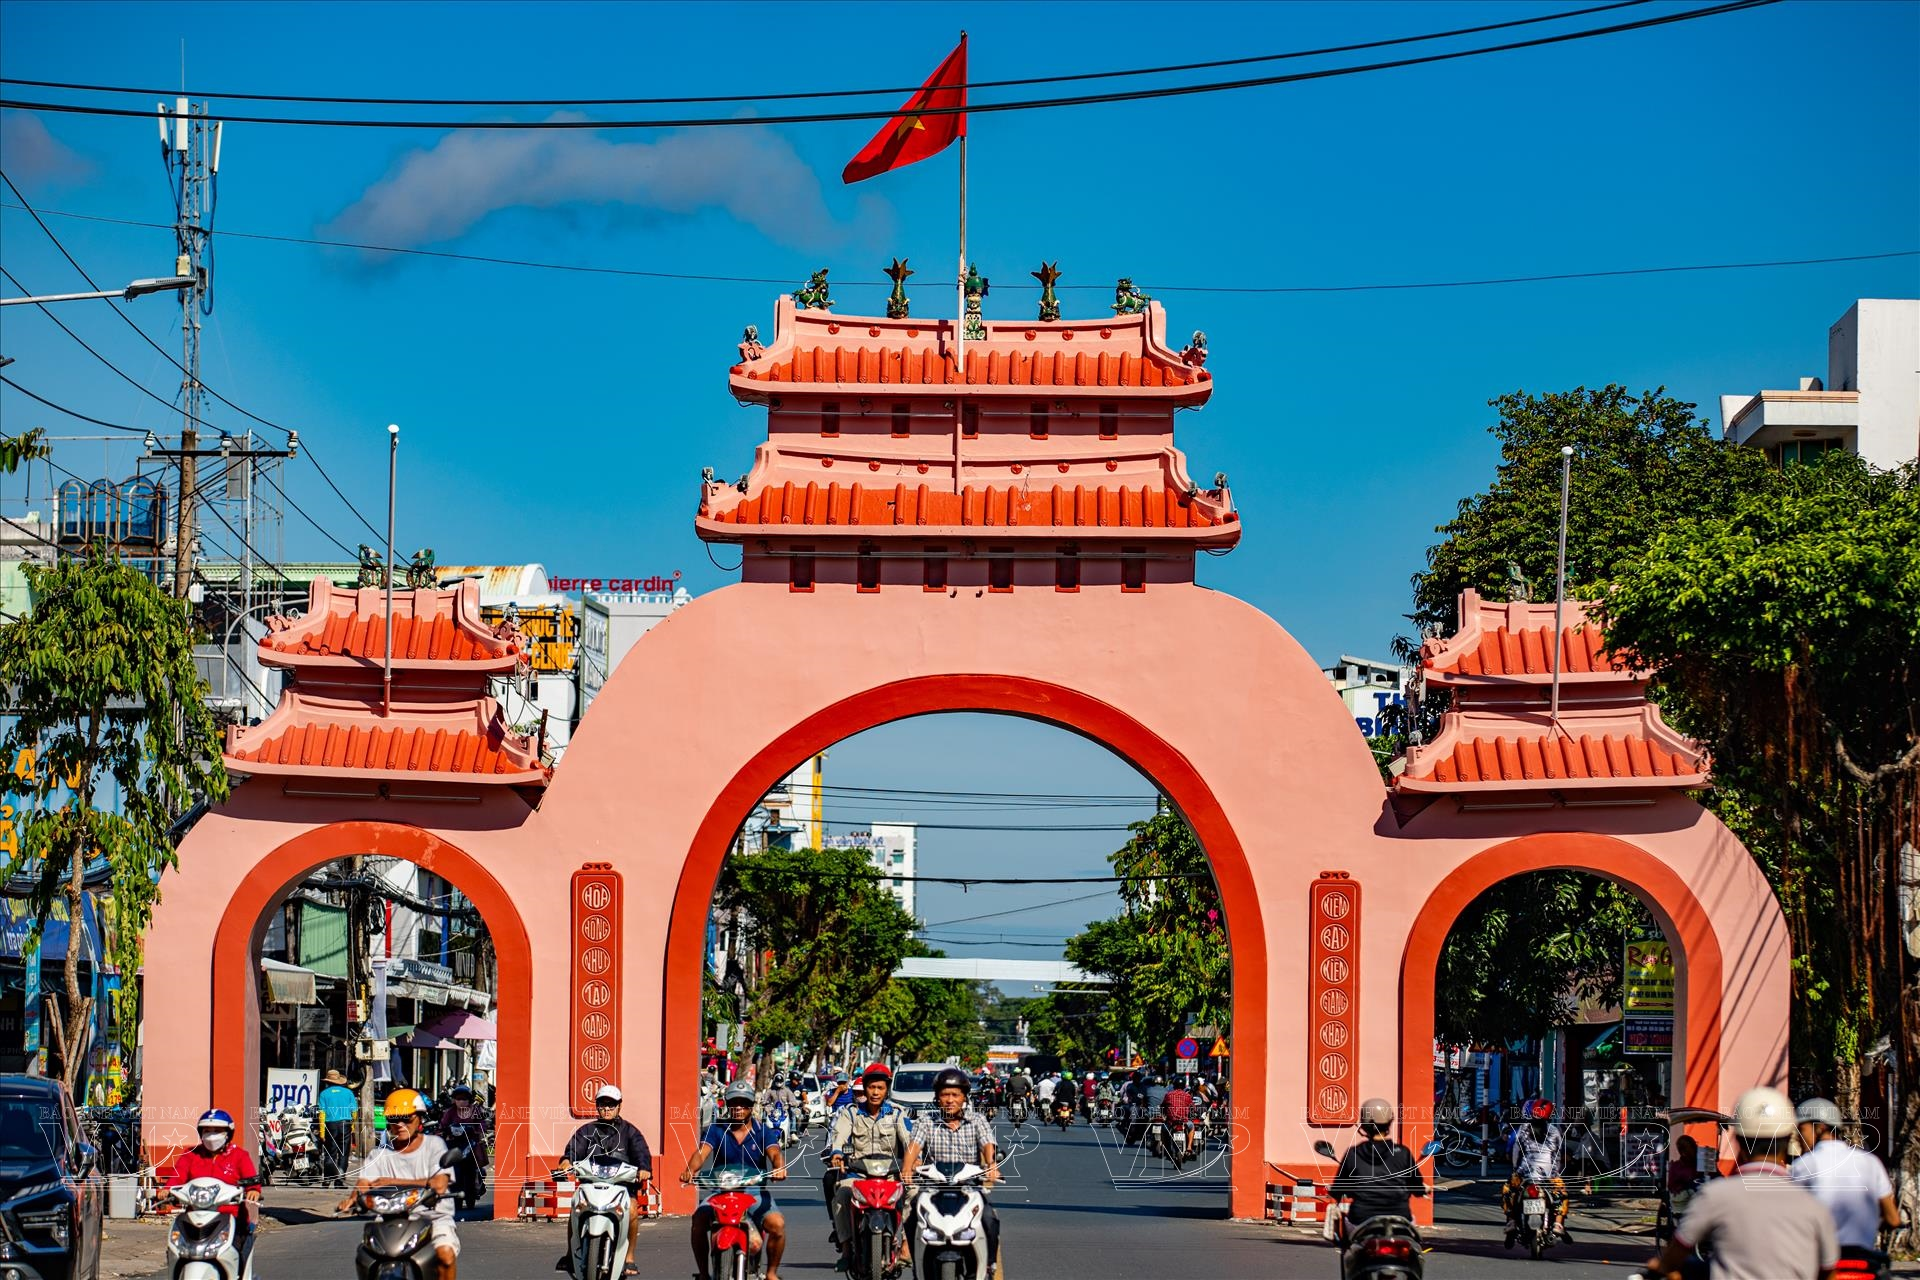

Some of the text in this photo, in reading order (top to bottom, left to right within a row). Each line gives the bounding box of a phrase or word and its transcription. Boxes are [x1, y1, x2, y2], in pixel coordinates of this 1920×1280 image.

[608, 576, 674, 592] cardin
[532, 642, 575, 671] CLINIC
[271, 1073, 313, 1114] PHỞ
